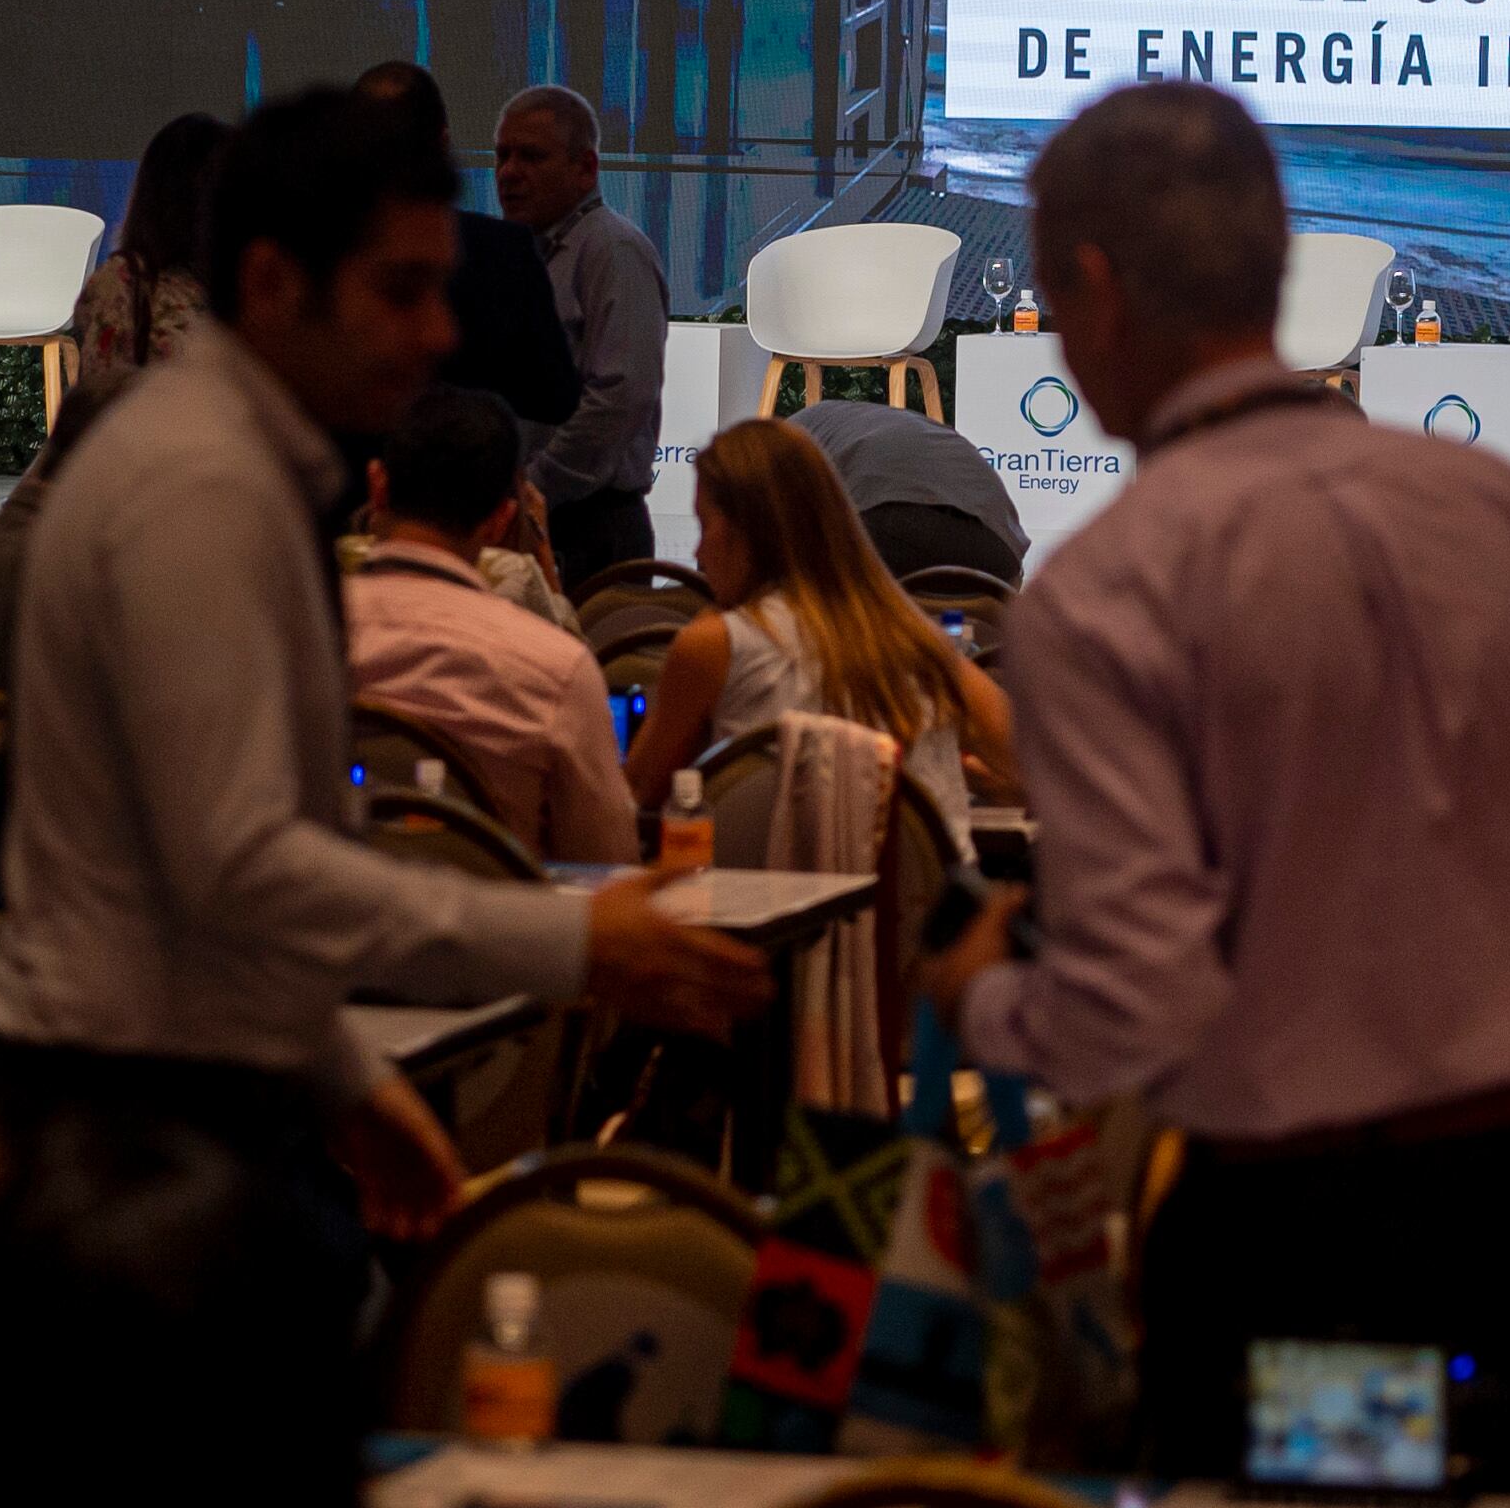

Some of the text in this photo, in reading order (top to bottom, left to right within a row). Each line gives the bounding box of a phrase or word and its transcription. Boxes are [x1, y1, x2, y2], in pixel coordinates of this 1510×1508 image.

[1017, 26, 1093, 81] DE
[1136, 19, 1433, 88] ENERGÍA
[1019, 474, 1080, 494] Energy
